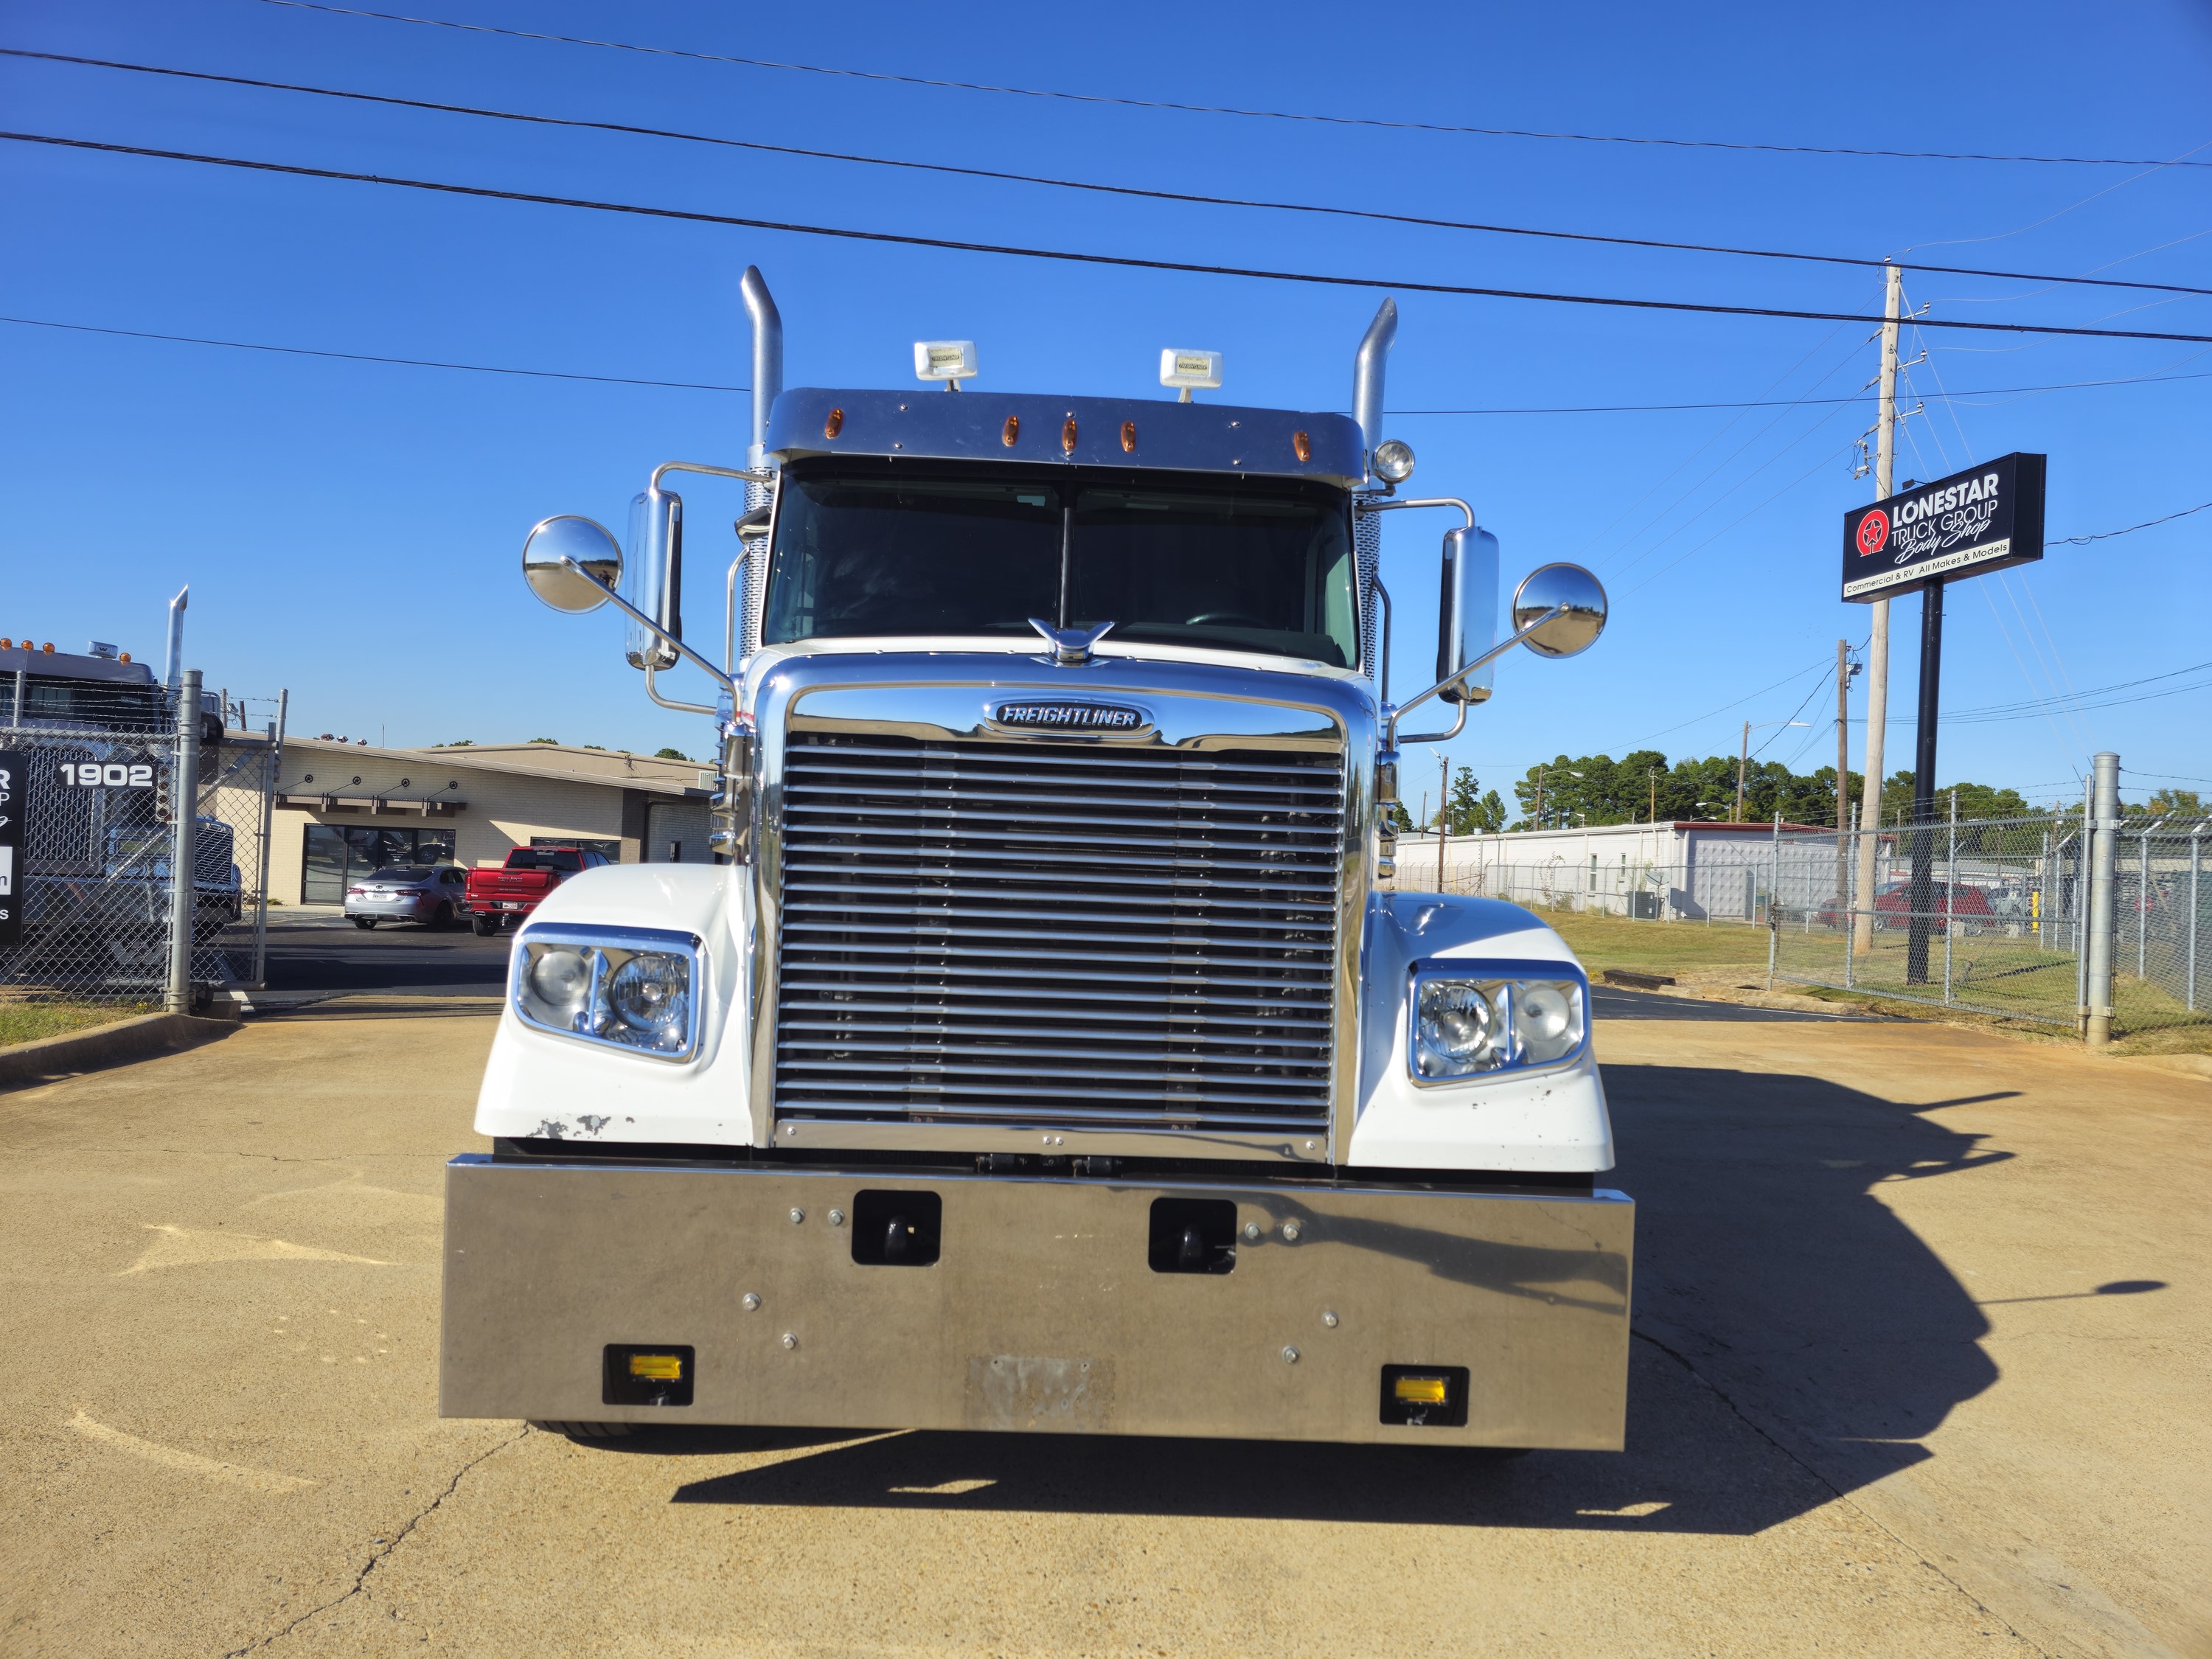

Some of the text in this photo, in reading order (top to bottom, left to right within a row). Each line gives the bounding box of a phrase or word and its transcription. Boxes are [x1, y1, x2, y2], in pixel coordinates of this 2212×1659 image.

[1891, 499, 1998, 546] TRUCK GROUP
[1893, 473, 1999, 529] LONESTAR
[1894, 518, 1992, 564] Body Shop
[1846, 543, 2008, 593] Commercial & RV All Makes & Models
[1003, 706, 1135, 727] FREIGHTLINER
[60, 764, 153, 787] 1902
